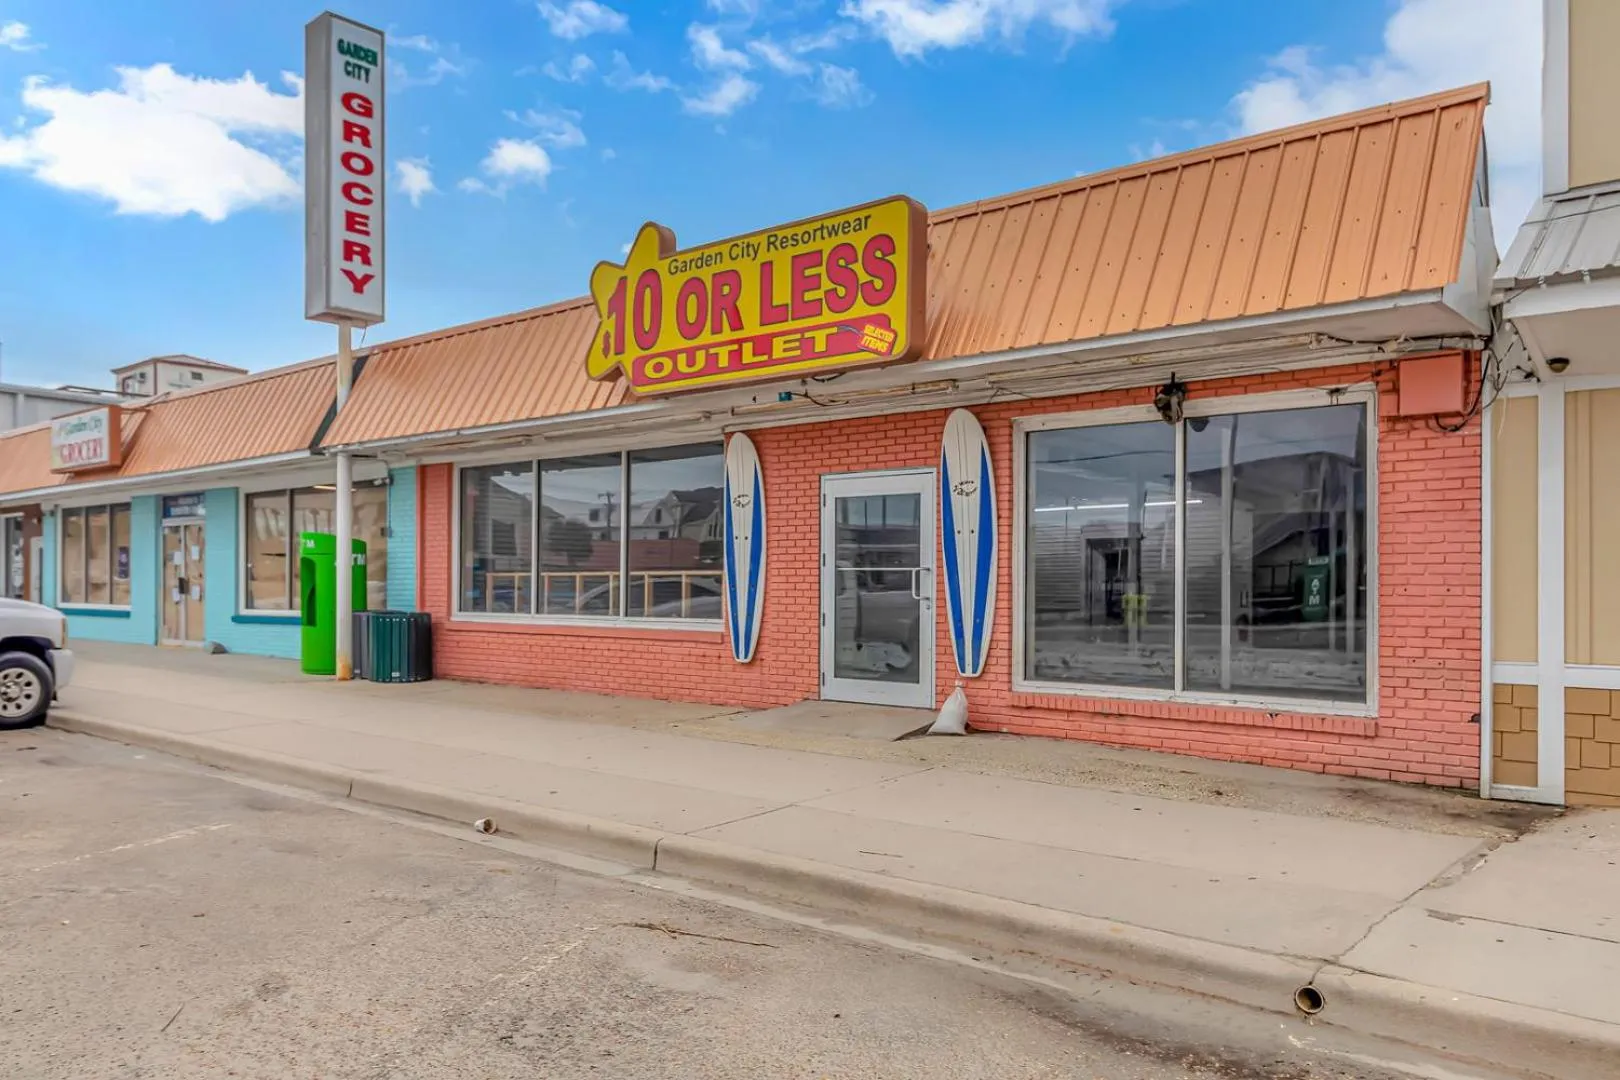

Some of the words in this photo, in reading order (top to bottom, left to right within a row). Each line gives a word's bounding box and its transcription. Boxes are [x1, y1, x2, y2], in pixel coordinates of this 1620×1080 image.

[337, 38, 378, 67] GARDEN
[344, 60, 371, 84] CITY
[340, 91, 375, 295] GROCERY
[667, 251, 724, 276] Garden
[728, 239, 761, 262] City
[766, 213, 872, 252] Resortwear
[675, 269, 744, 341] OR
[759, 233, 898, 327] LESS
[643, 326, 839, 379] OUTLET
